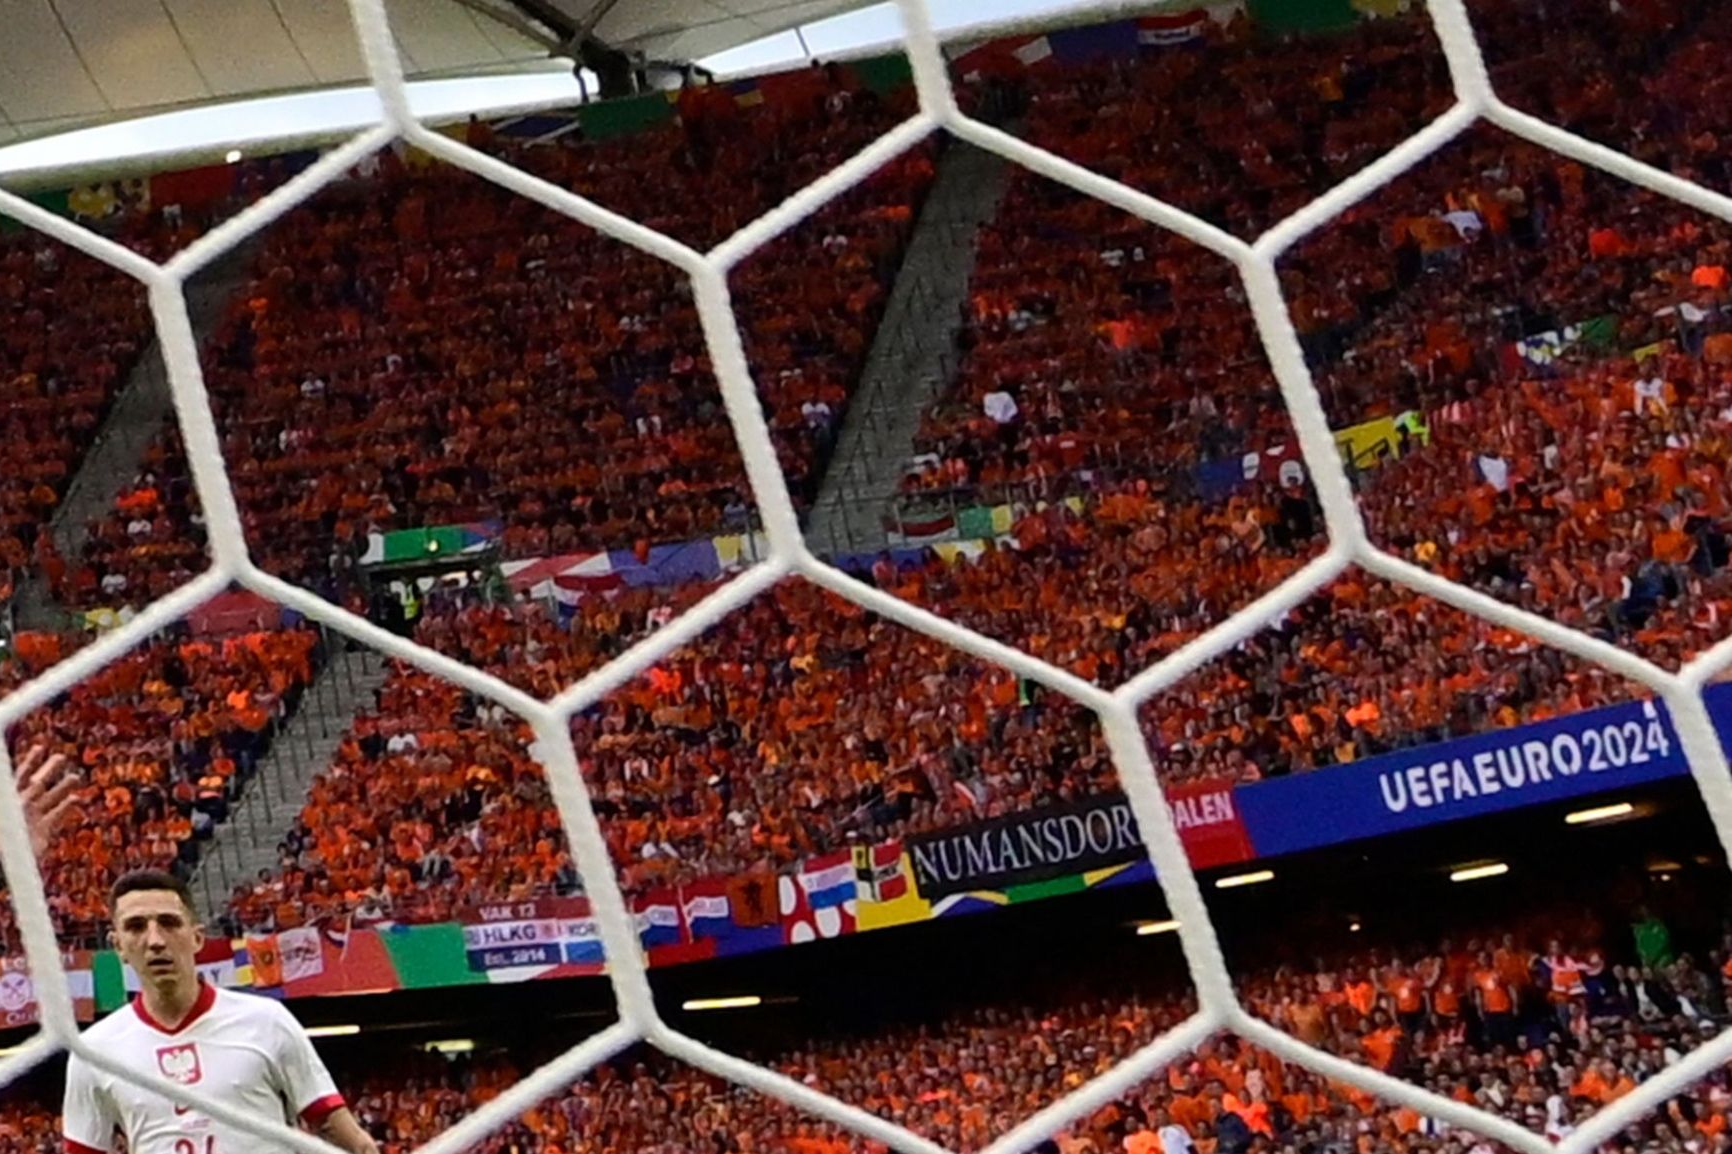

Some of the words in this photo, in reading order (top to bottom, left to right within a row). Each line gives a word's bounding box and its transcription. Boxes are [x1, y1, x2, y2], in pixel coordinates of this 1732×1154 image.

[1169, 791, 1235, 829] ALEN
[913, 803, 1142, 884] NUMANSDOR
[483, 924, 537, 942] HLKG
